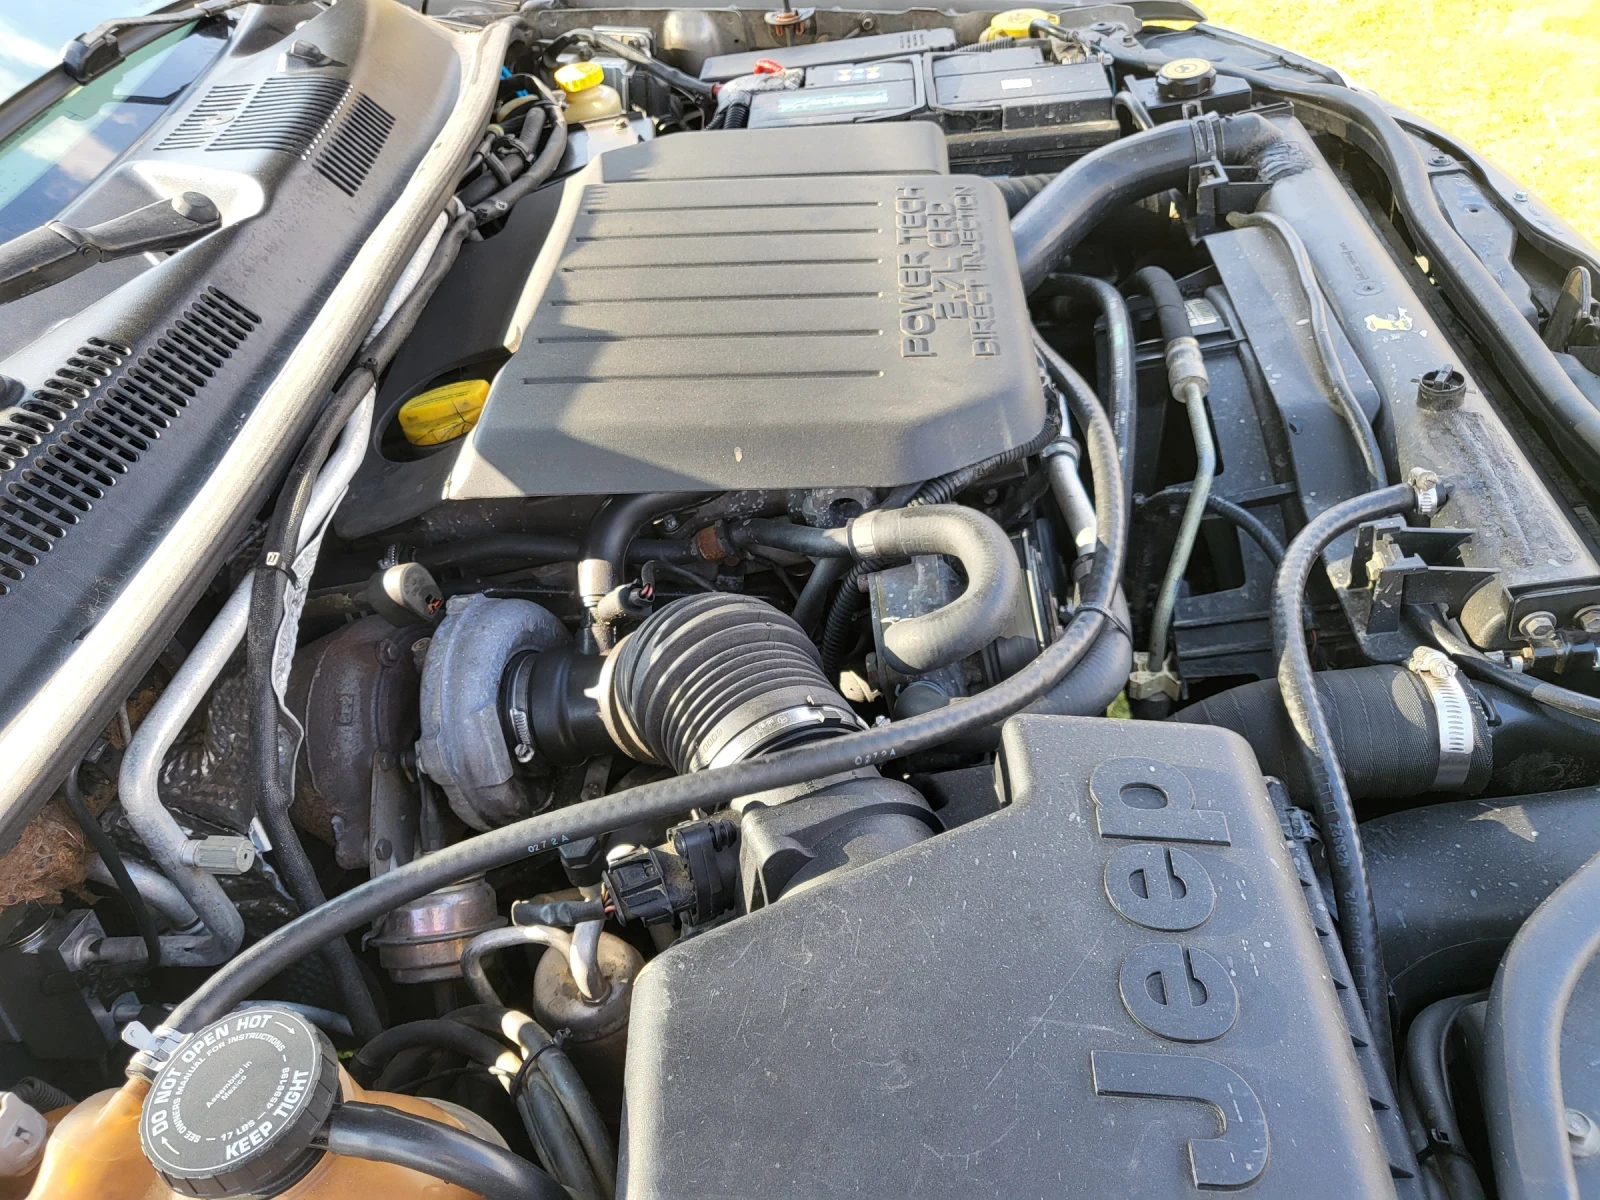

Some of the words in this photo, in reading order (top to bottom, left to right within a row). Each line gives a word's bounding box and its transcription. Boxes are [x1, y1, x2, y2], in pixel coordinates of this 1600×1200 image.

[896, 186, 929, 246] TECH
[926, 202, 961, 249] CRD
[954, 186, 988, 272] INJECTION
[898, 251, 937, 358] POWER
[930, 255, 968, 320] 2.7L
[964, 279, 1000, 357] DIRECT
[1089, 756, 1271, 1191] Jeep
[228, 1032, 286, 1052] INSTRUCTIONS
[236, 1014, 273, 1031] HOT
[181, 1023, 230, 1063] OPEN
[206, 1041, 226, 1056] FOR
[154, 1067, 182, 1104] NOT
[176, 1057, 206, 1095] MANUAL
[206, 1067, 244, 1108] Assembled
[221, 1075, 247, 1101] Mexico
[151, 1109, 169, 1137] DO
[172, 1097, 187, 1134] OWNERS
[225, 1121, 273, 1160] KEEP
[273, 1069, 309, 1119] TIGHT
[236, 1119, 255, 1136] LBS
[184, 1130, 201, 1143] SEE
